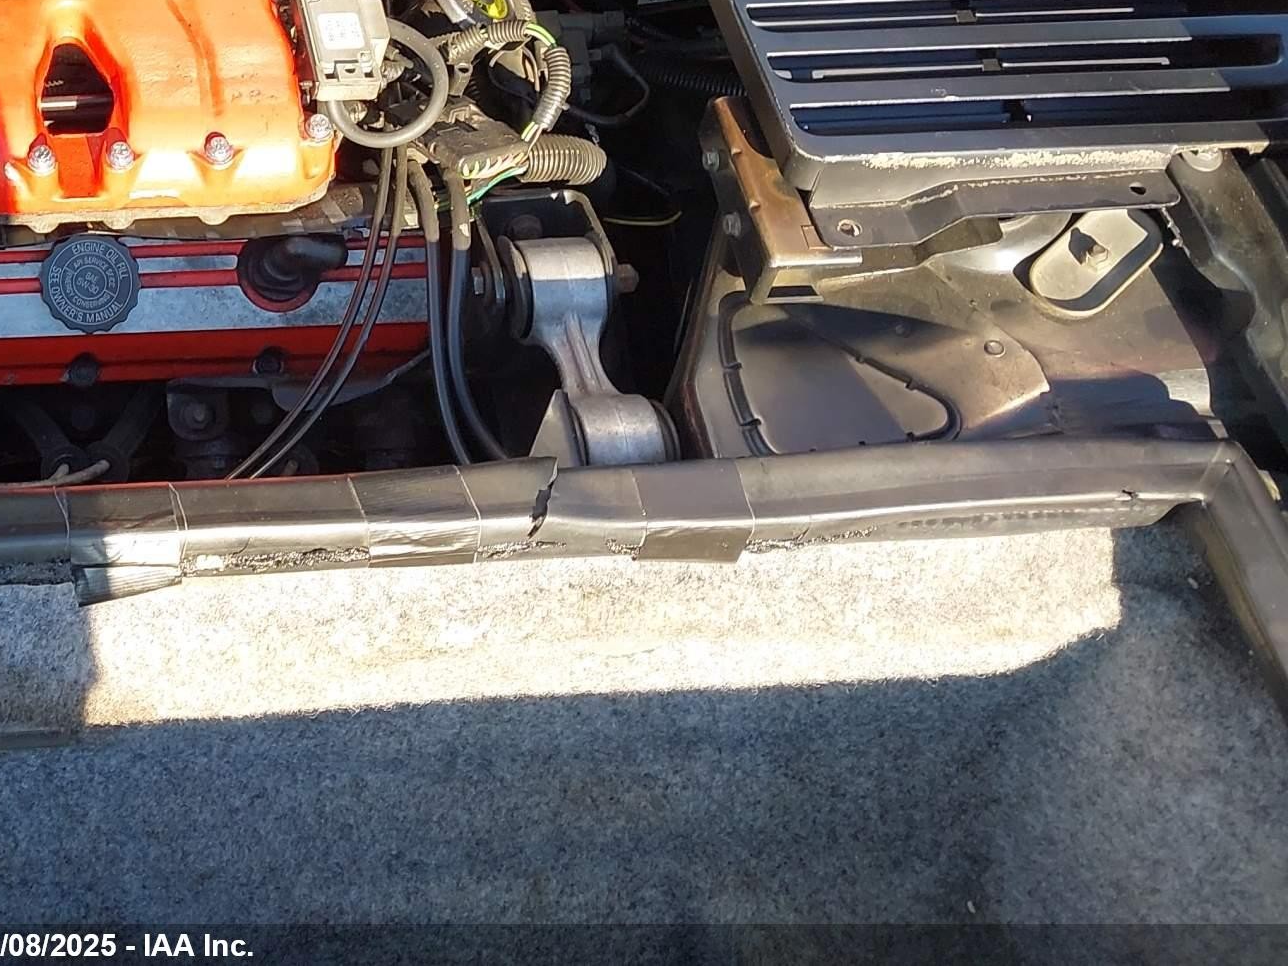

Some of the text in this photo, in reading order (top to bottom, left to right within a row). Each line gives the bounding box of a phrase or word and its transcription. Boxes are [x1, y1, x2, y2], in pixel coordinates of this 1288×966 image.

[72, 242, 129, 280] ENGINE OIL FILL
[50, 266, 124, 323] SEE OWNER'S MANUAL
